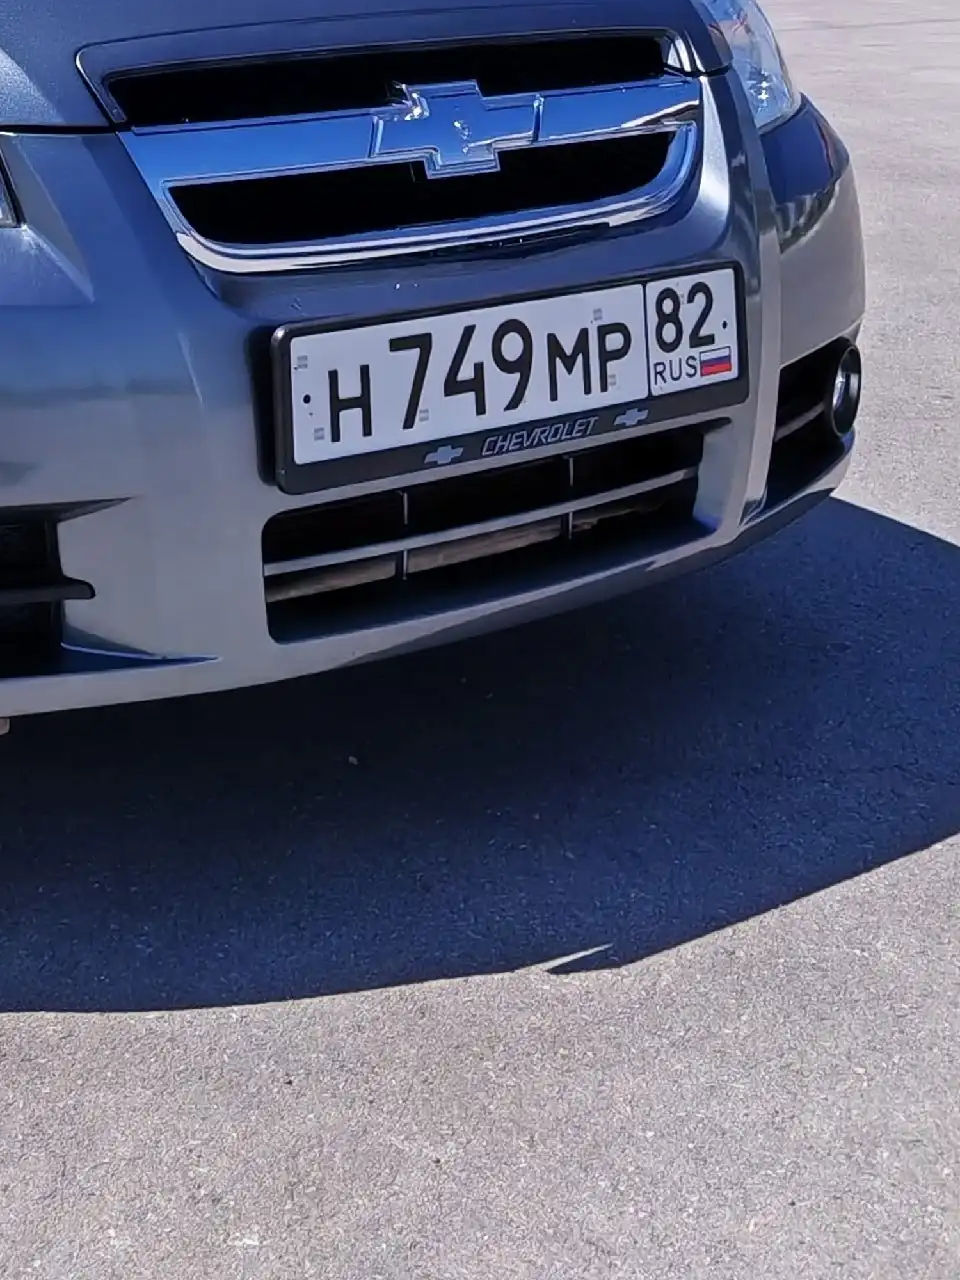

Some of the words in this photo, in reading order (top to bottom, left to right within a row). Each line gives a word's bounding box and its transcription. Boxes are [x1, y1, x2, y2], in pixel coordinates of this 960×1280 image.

[655, 282, 716, 353] 82
[653, 354, 698, 385] RUS
[481, 416, 599, 456] CHEVROLET
